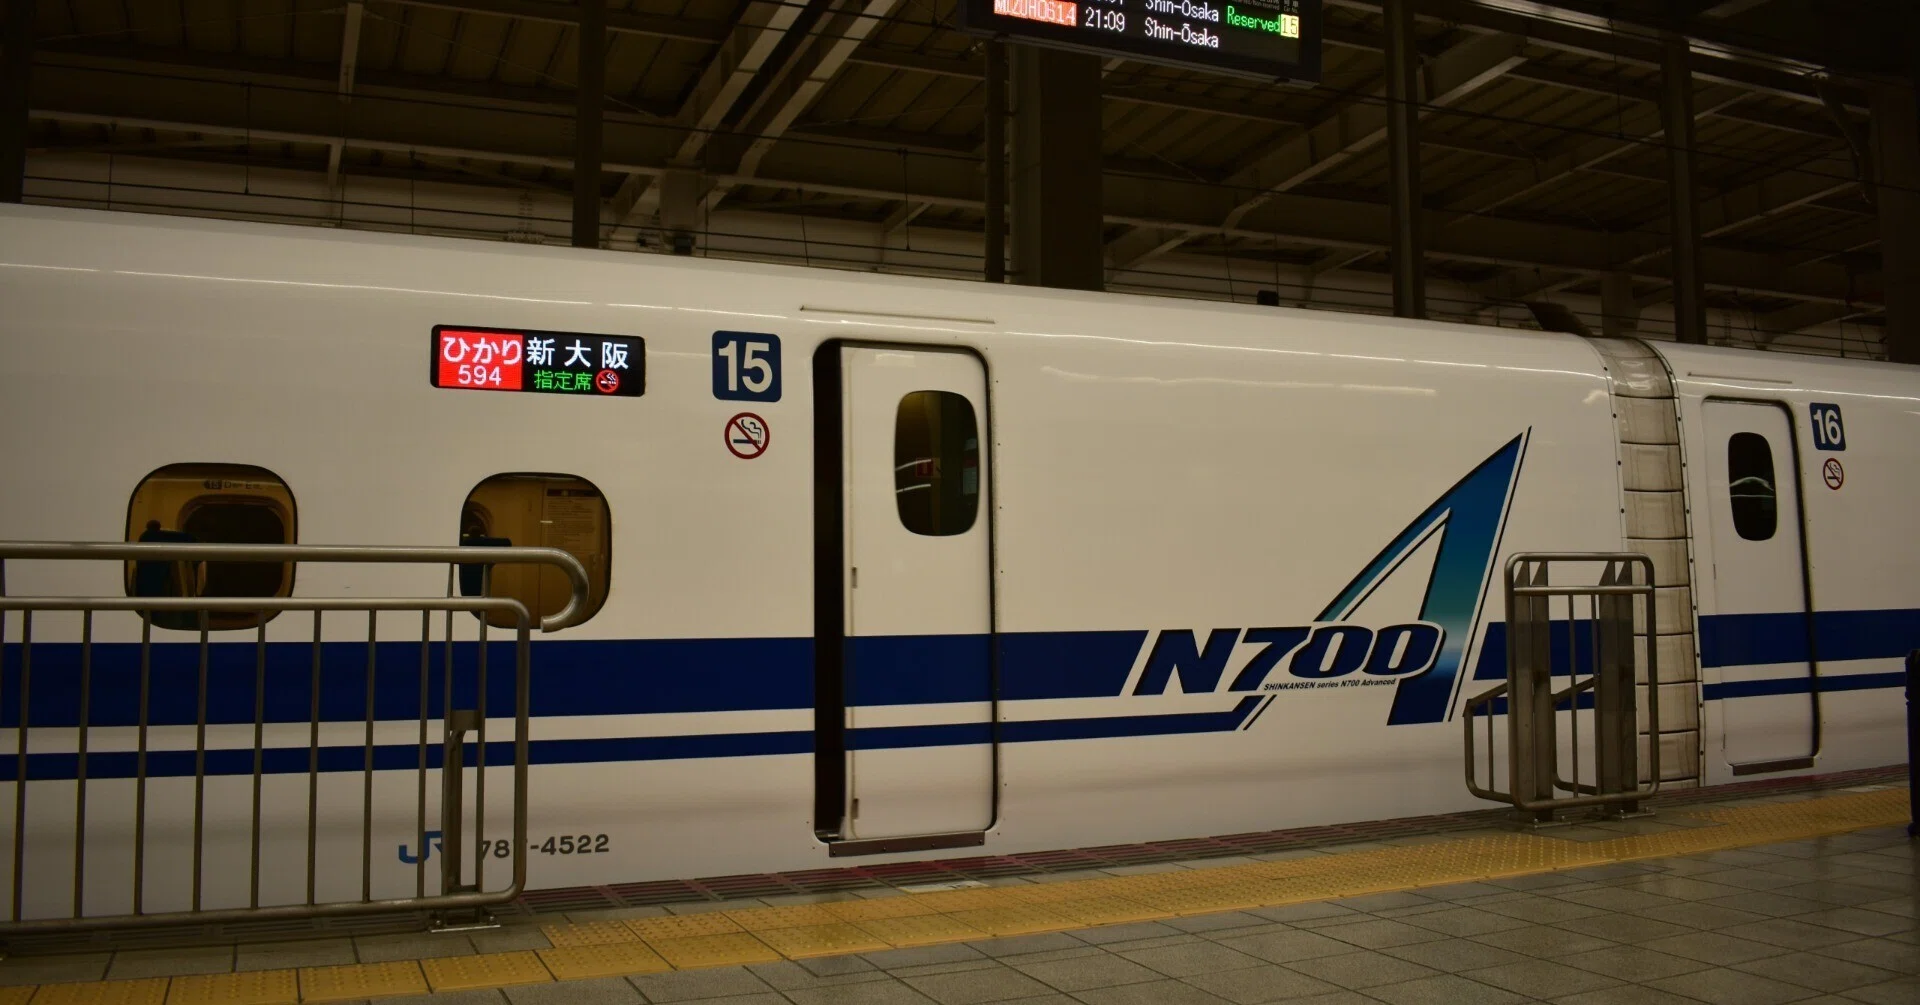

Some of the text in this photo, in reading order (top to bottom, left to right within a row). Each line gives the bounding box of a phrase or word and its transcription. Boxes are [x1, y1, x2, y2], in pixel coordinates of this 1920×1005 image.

[1085, 7, 1125, 32] 21:09
[1227, 5, 1281, 33] Reserved
[1281, 15, 1298, 36] 15
[443, 336, 522, 366] ひかり
[526, 336, 629, 370] 新大阪
[458, 366, 502, 387] 594
[718, 340, 774, 393] 15
[534, 370, 593, 392] 指定席
[1813, 408, 1842, 445] 16
[1132, 623, 1446, 697] N700
[1263, 678, 1396, 691] SHINKANSEN series N700 Advanced
